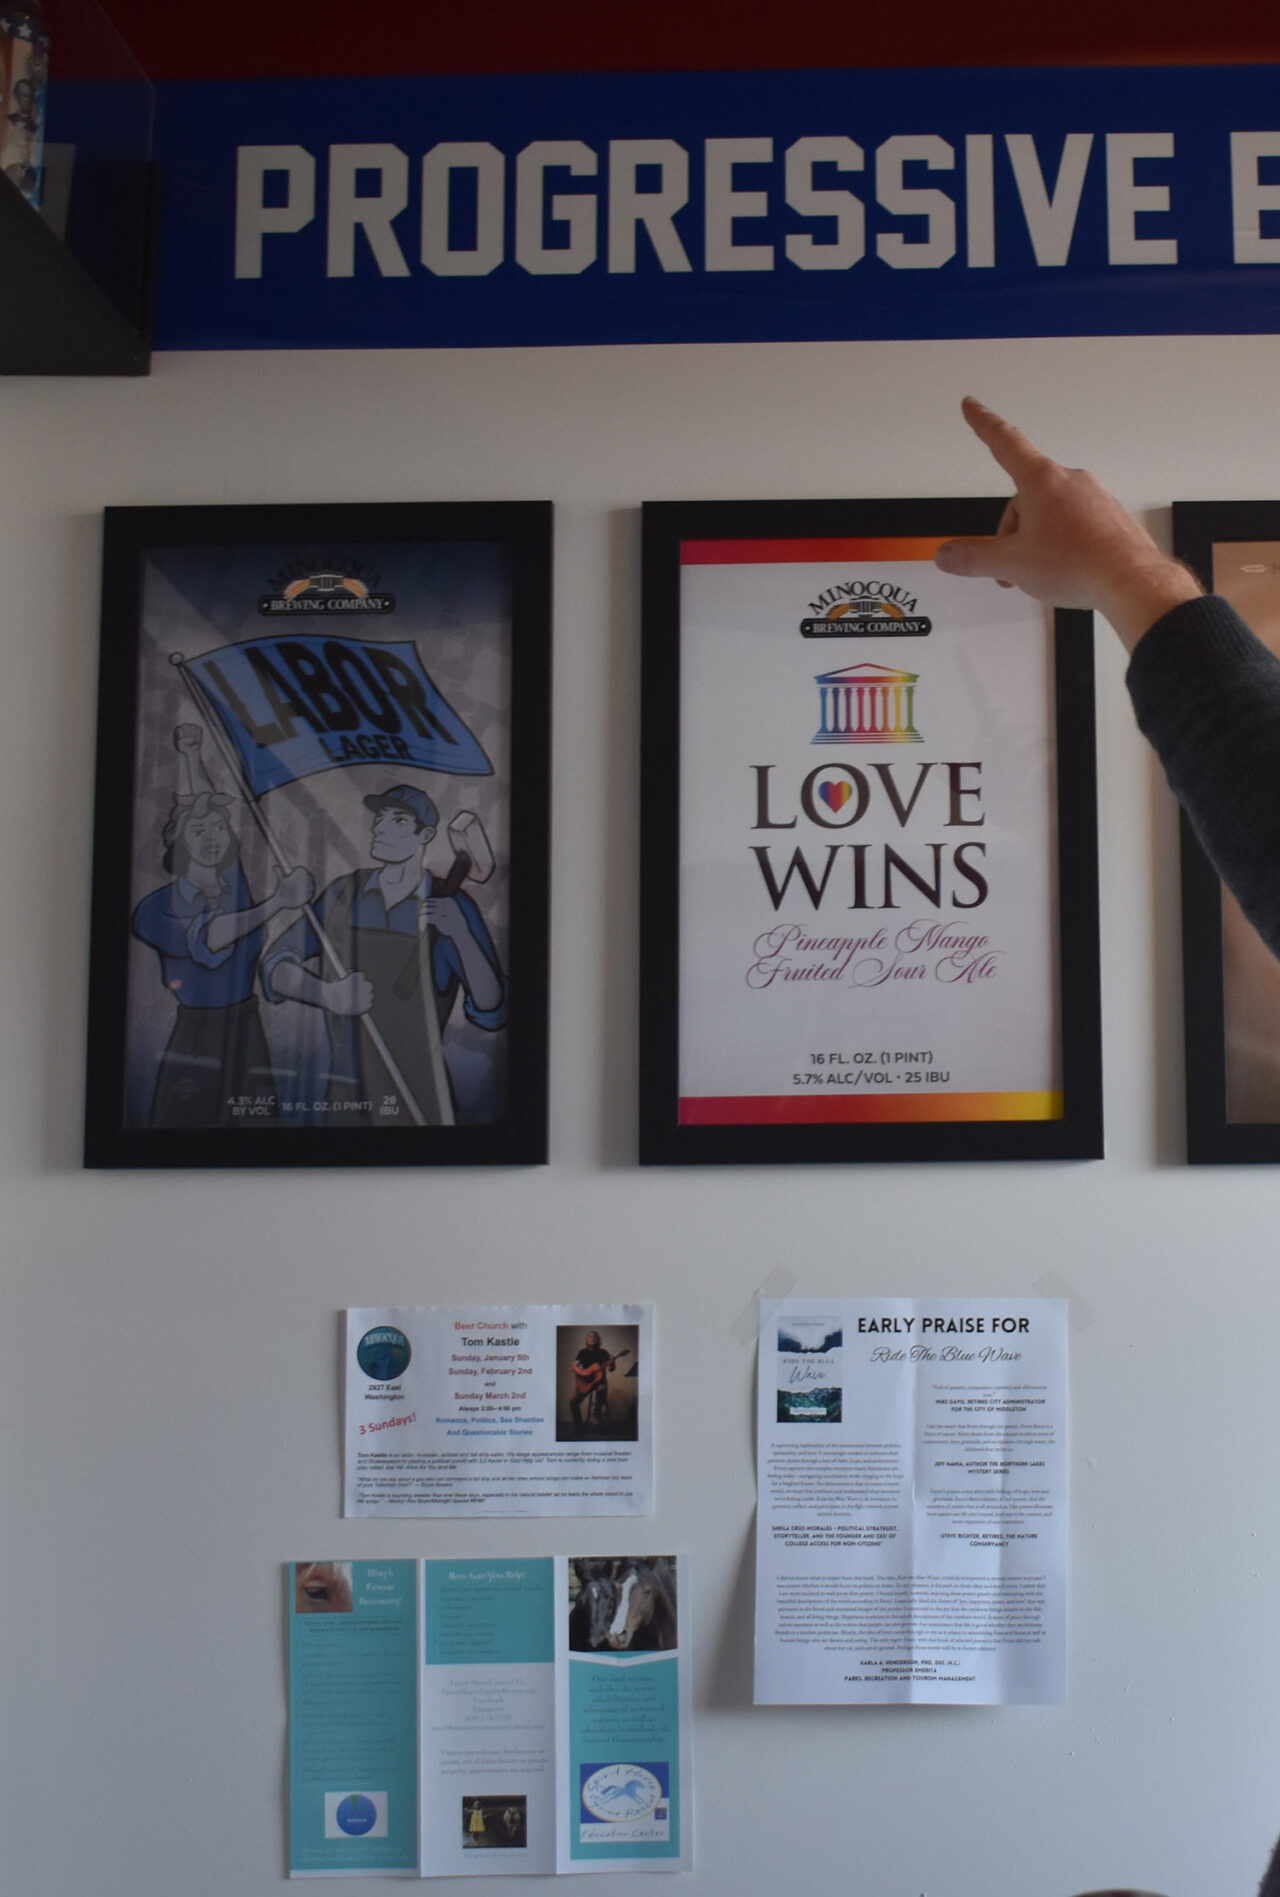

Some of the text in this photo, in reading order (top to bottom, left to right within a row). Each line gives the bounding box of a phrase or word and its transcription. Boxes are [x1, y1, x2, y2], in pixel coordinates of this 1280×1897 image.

[235, 133, 1178, 279] PROGRESSIVE
[270, 598, 385, 611] BREWING COMPANY
[808, 581, 918, 614] MINOCQUA
[813, 621, 922, 633] BREWING COMPANY
[203, 641, 459, 748] LABOR
[319, 733, 415, 763] LAGER
[749, 762, 986, 829] LOVE
[748, 842, 988, 911] WINS
[754, 919, 990, 961] Pineapple Mango
[746, 951, 1005, 989] Fruited Sour Ale
[810, 1051, 933, 1065] 16 FL. OZ. (1 PINT)
[793, 1070, 950, 1085] 5.7% ALC/VOL 25 IBU
[282, 1102, 293, 1111] 16
[454, 1322, 474, 1330] Beer
[477, 1321, 509, 1329] Church
[858, 1317, 1030, 1333] EARLY PRAISE FOR
[462, 1337, 520, 1346] Tom Kastle
[870, 1345, 1023, 1362] Ride The Blue Wave
[481, 1368, 516, 1376] February
[485, 1392, 510, 1400] March
[359, 1412, 417, 1435] 3 Sundays!
